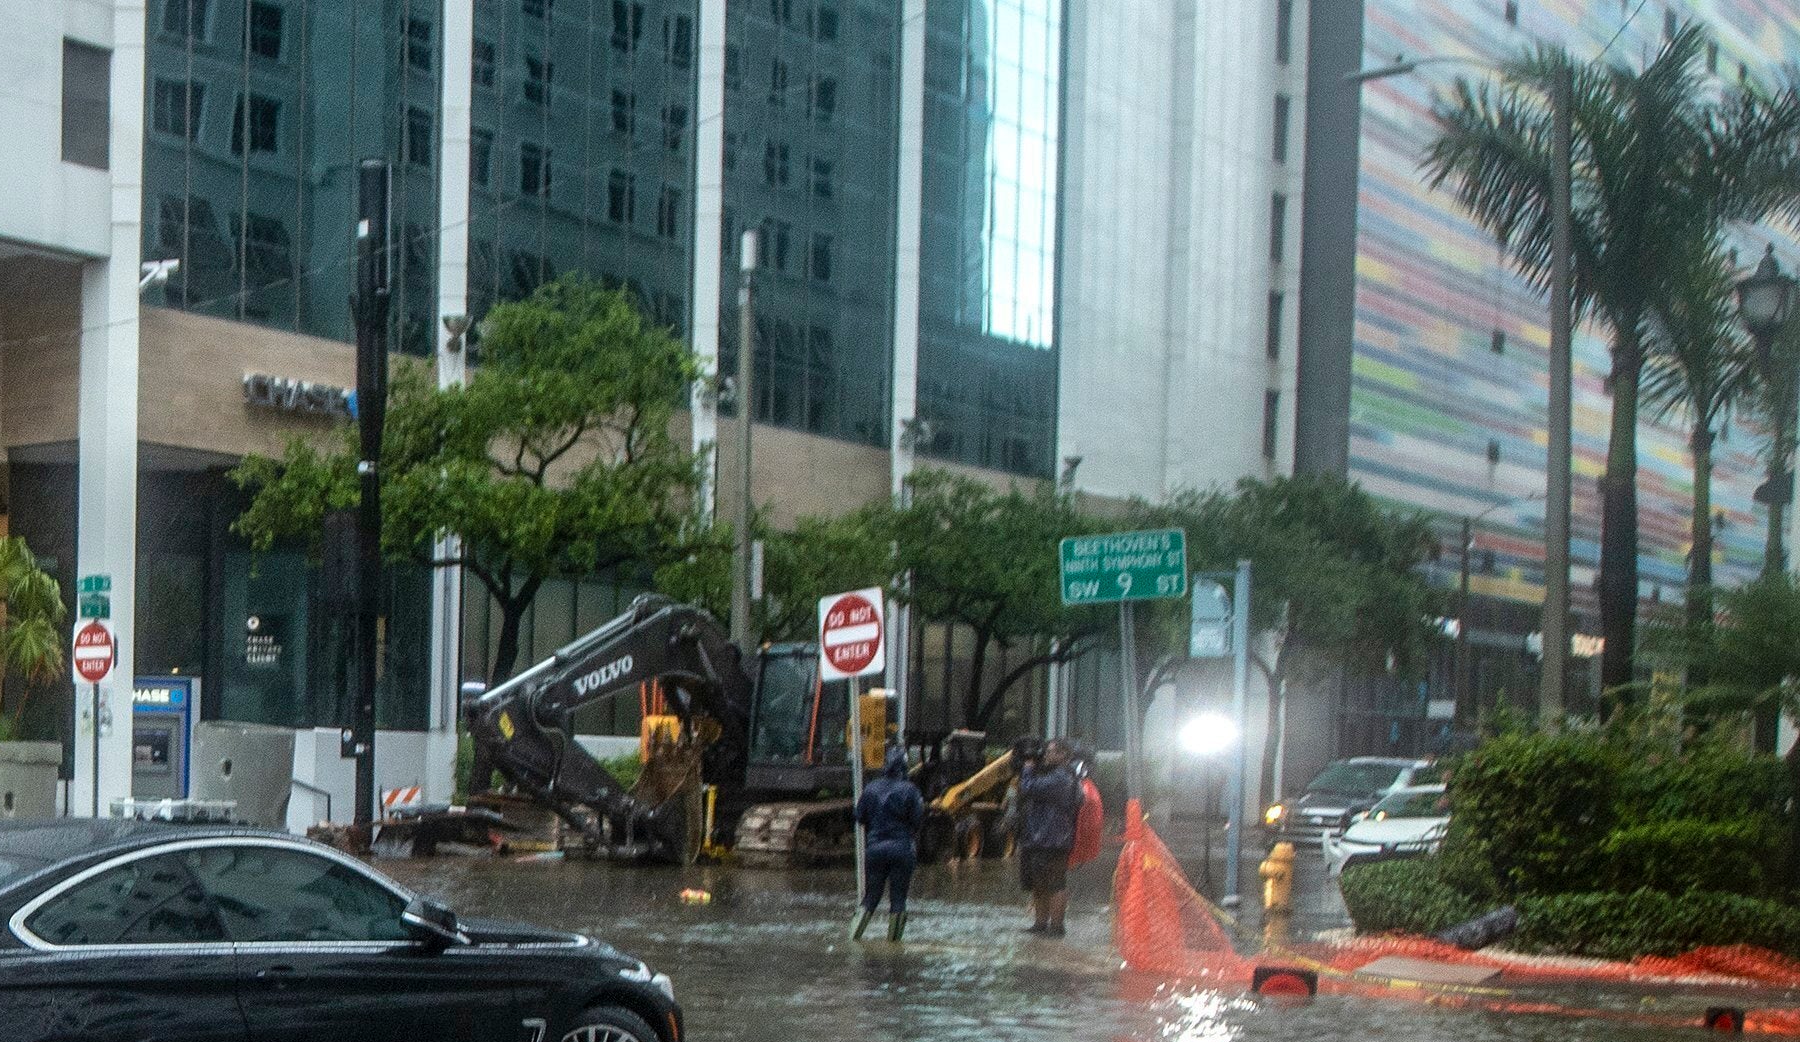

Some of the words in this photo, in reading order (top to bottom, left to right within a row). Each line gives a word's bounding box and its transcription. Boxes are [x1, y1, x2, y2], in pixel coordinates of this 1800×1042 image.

[1103, 553, 1162, 572] SYMPHONY
[1166, 551, 1181, 568] ST
[1068, 580, 1100, 599] SW
[1117, 572, 1133, 599] 9
[1156, 574, 1180, 594] ST
[828, 611, 845, 628] DO
[849, 605, 872, 624] NOT
[80, 633, 91, 644] DO
[93, 632, 106, 644] NOT
[834, 643, 870, 663] ENTER
[82, 661, 105, 672] ENTER
[573, 654, 633, 695] VOLVO
[132, 689, 169, 703] HASE
